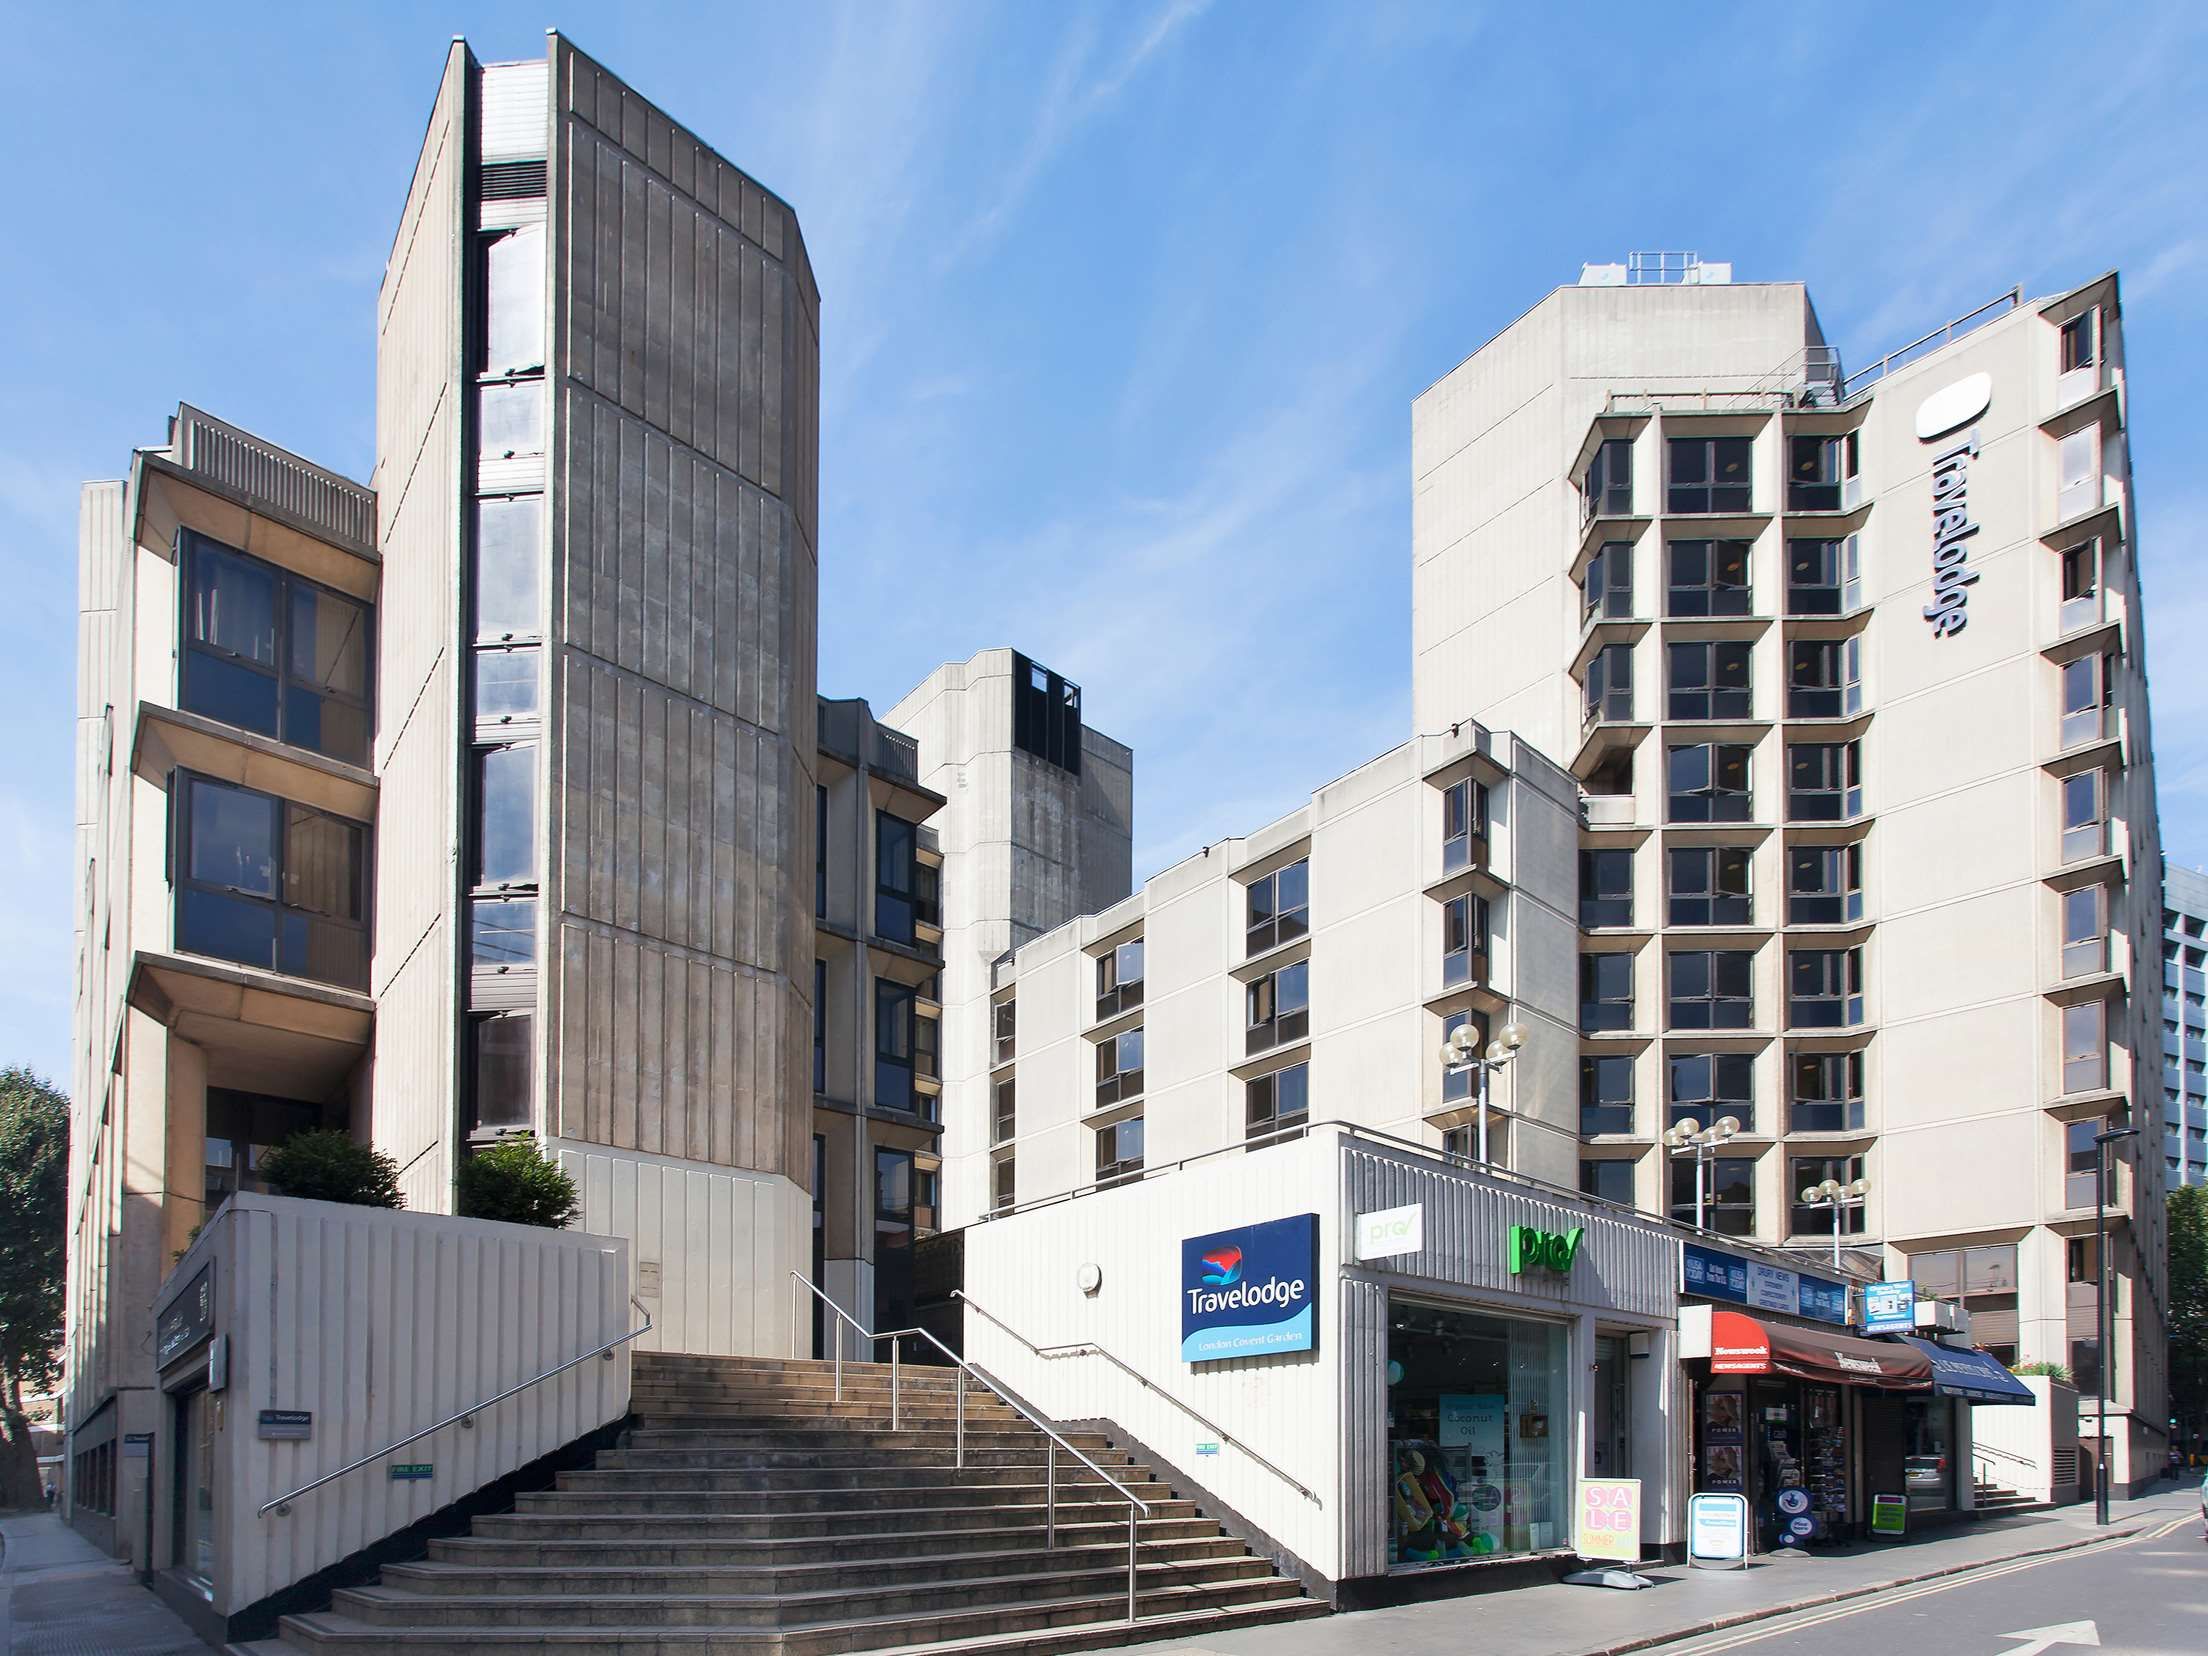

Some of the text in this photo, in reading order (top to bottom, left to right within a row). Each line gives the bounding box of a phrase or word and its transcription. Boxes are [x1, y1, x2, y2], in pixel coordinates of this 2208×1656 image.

[1923, 426, 1981, 639] Travelodge
[1187, 1276, 1305, 1315] Travelodge
[1199, 1331, 1302, 1352] London Covent Garden
[1447, 1413, 1493, 1423] Coconut
[1460, 1426, 1476, 1436] Oil
[392, 1464, 433, 1473] FIRE EXIT
